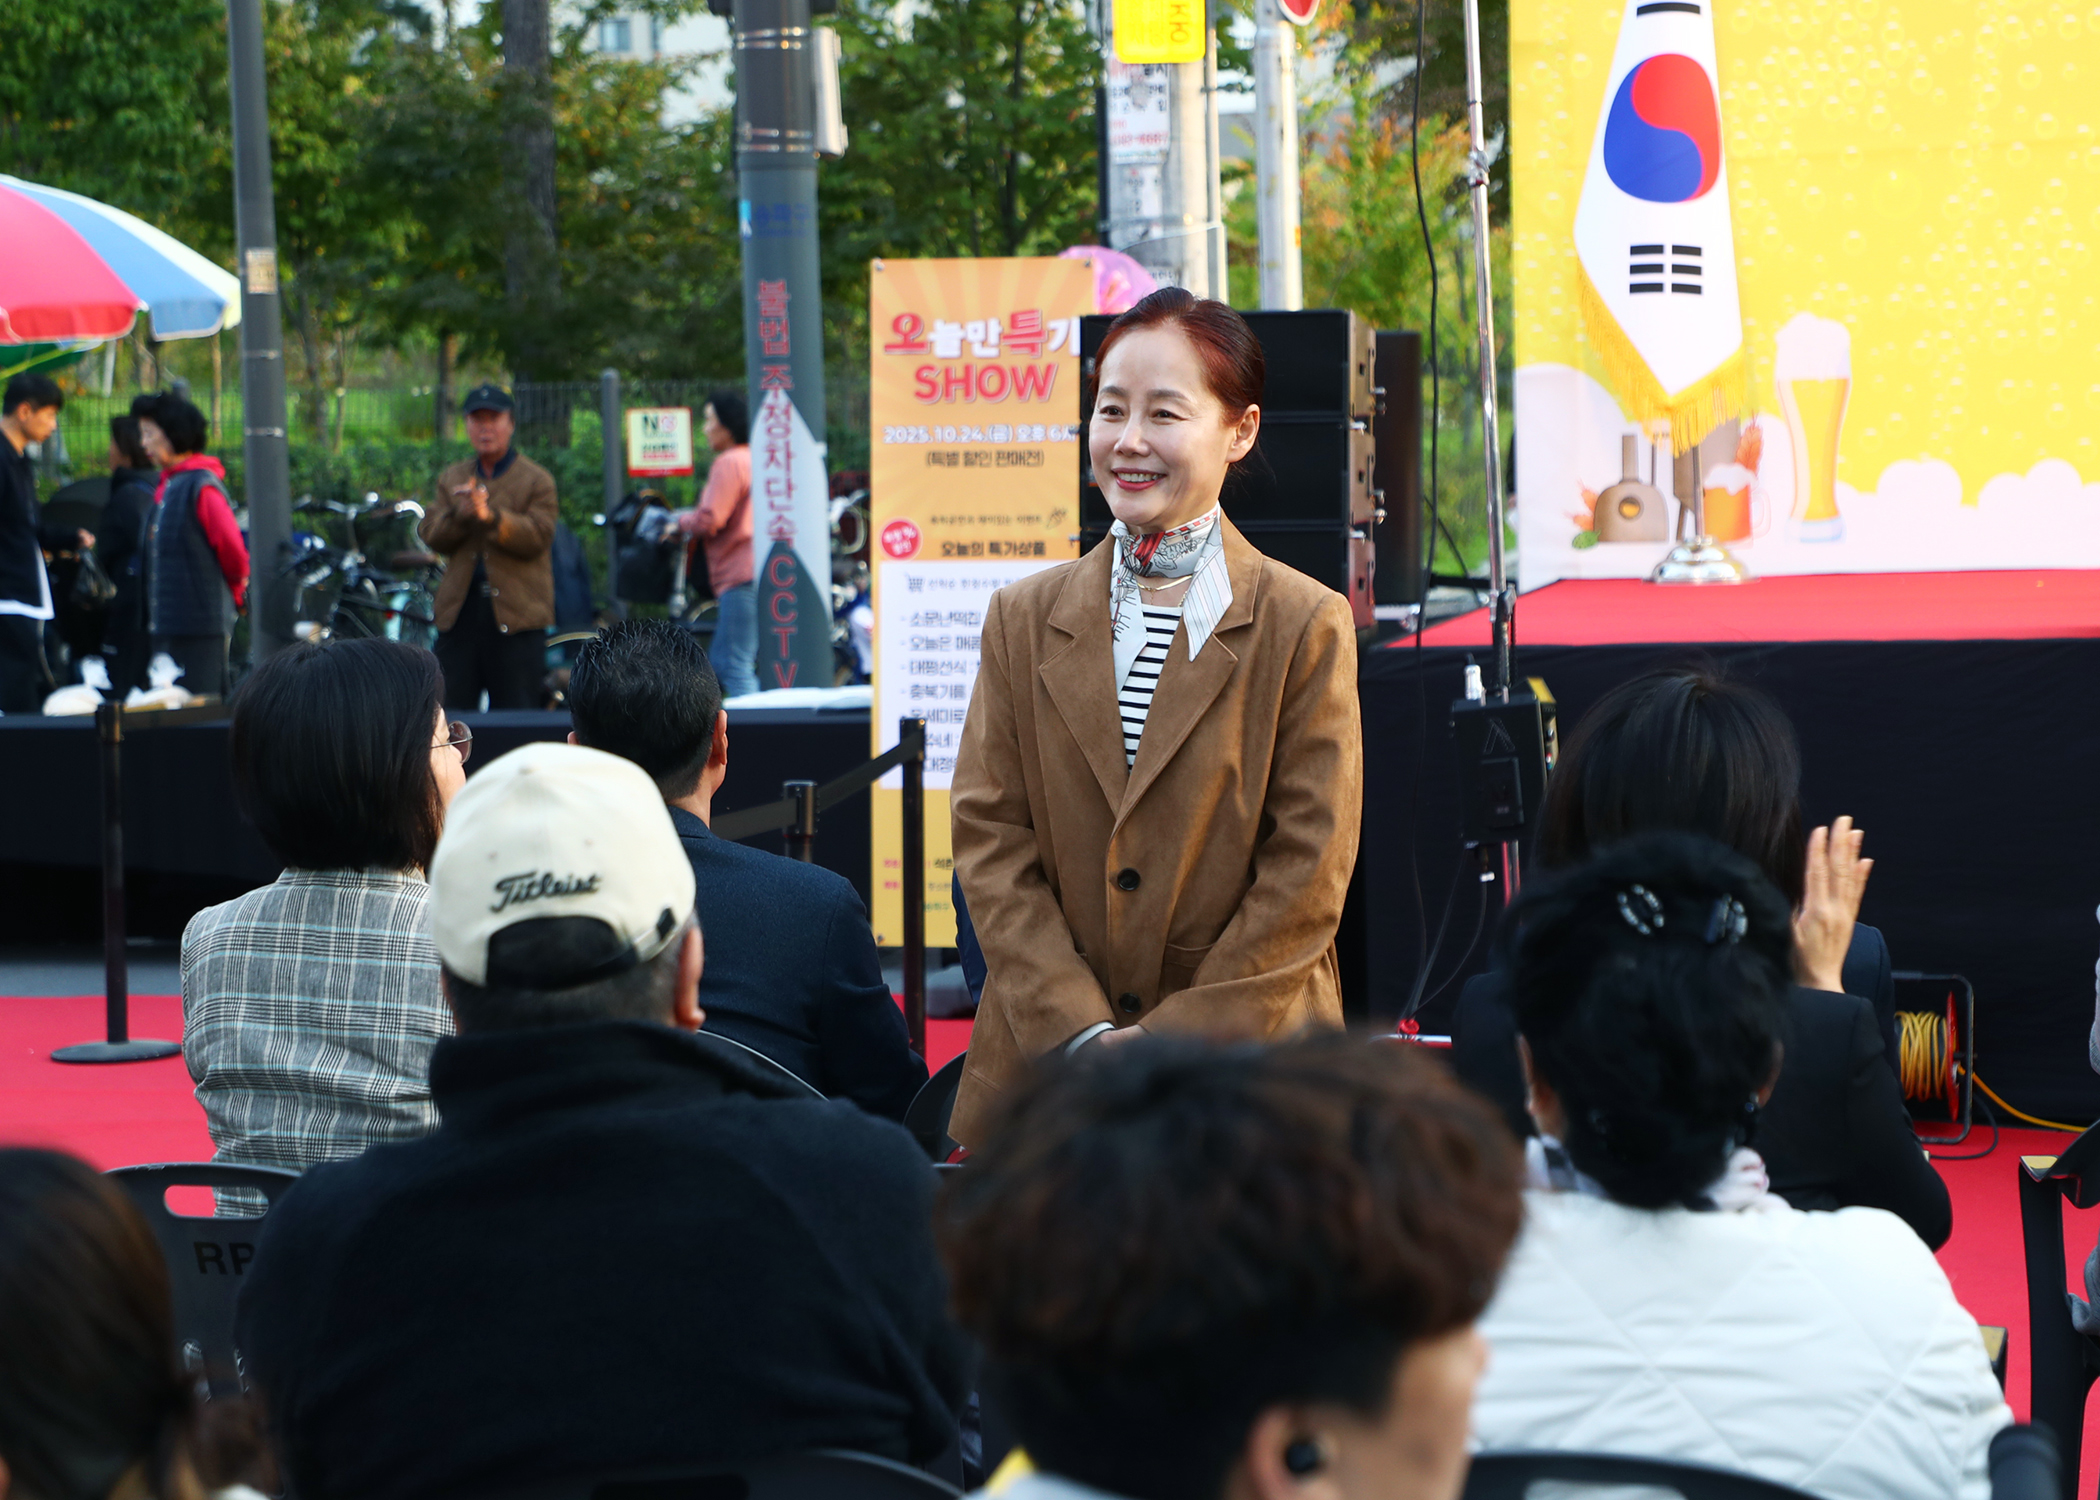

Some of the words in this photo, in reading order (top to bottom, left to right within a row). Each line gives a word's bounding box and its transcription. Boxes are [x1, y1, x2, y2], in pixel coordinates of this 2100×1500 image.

[758, 279, 791, 355] 불법
[915, 363, 1058, 404] SHOW
[1016, 424, 1047, 443] 오후
[760, 365, 798, 548] 주정차단속
[927, 450, 960, 467] (특별
[963, 450, 992, 467] 할인
[942, 541, 984, 557] 오늘의
[989, 541, 1045, 557] 특가상품
[769, 554, 798, 689] CCTV
[910, 610, 981, 628] 소문난떡집
[910, 635, 952, 652] 오늘은
[910, 684, 966, 700] 충북기름
[490, 869, 601, 913] Titleist
